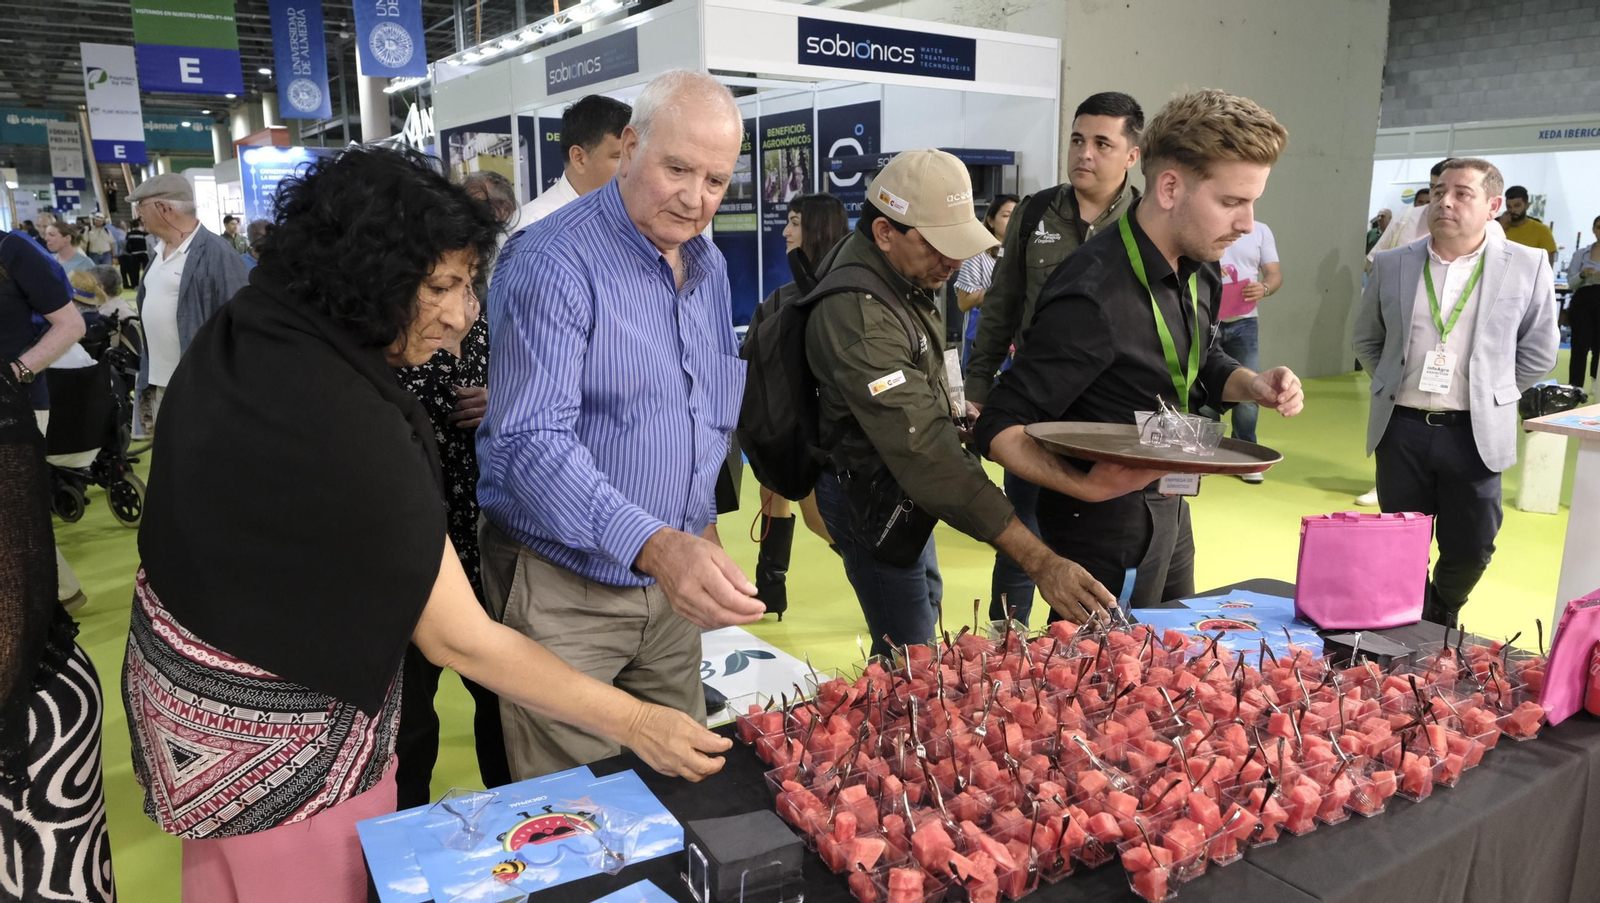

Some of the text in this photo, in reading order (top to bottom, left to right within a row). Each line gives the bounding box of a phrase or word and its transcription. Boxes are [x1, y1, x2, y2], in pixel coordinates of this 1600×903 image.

[287, 7, 302, 75] UNIVERSIDAD
[806, 33, 915, 64] sobionics
[920, 46, 943, 54] WATER
[920, 53, 959, 63] TREATMENT
[179, 57, 204, 84] E
[301, 60, 312, 75] DE
[549, 56, 602, 85] sobionics
[920, 62, 971, 72] TECHNOLOGIES
[767, 124, 806, 138] BENEFICIOS
[1538, 130, 1562, 140] XEDA
[762, 134, 812, 150] AGRONÓMICOS
[114, 144, 126, 159] E
[66, 180, 74, 188] E
[508, 795, 548, 808] COEXPHAL
